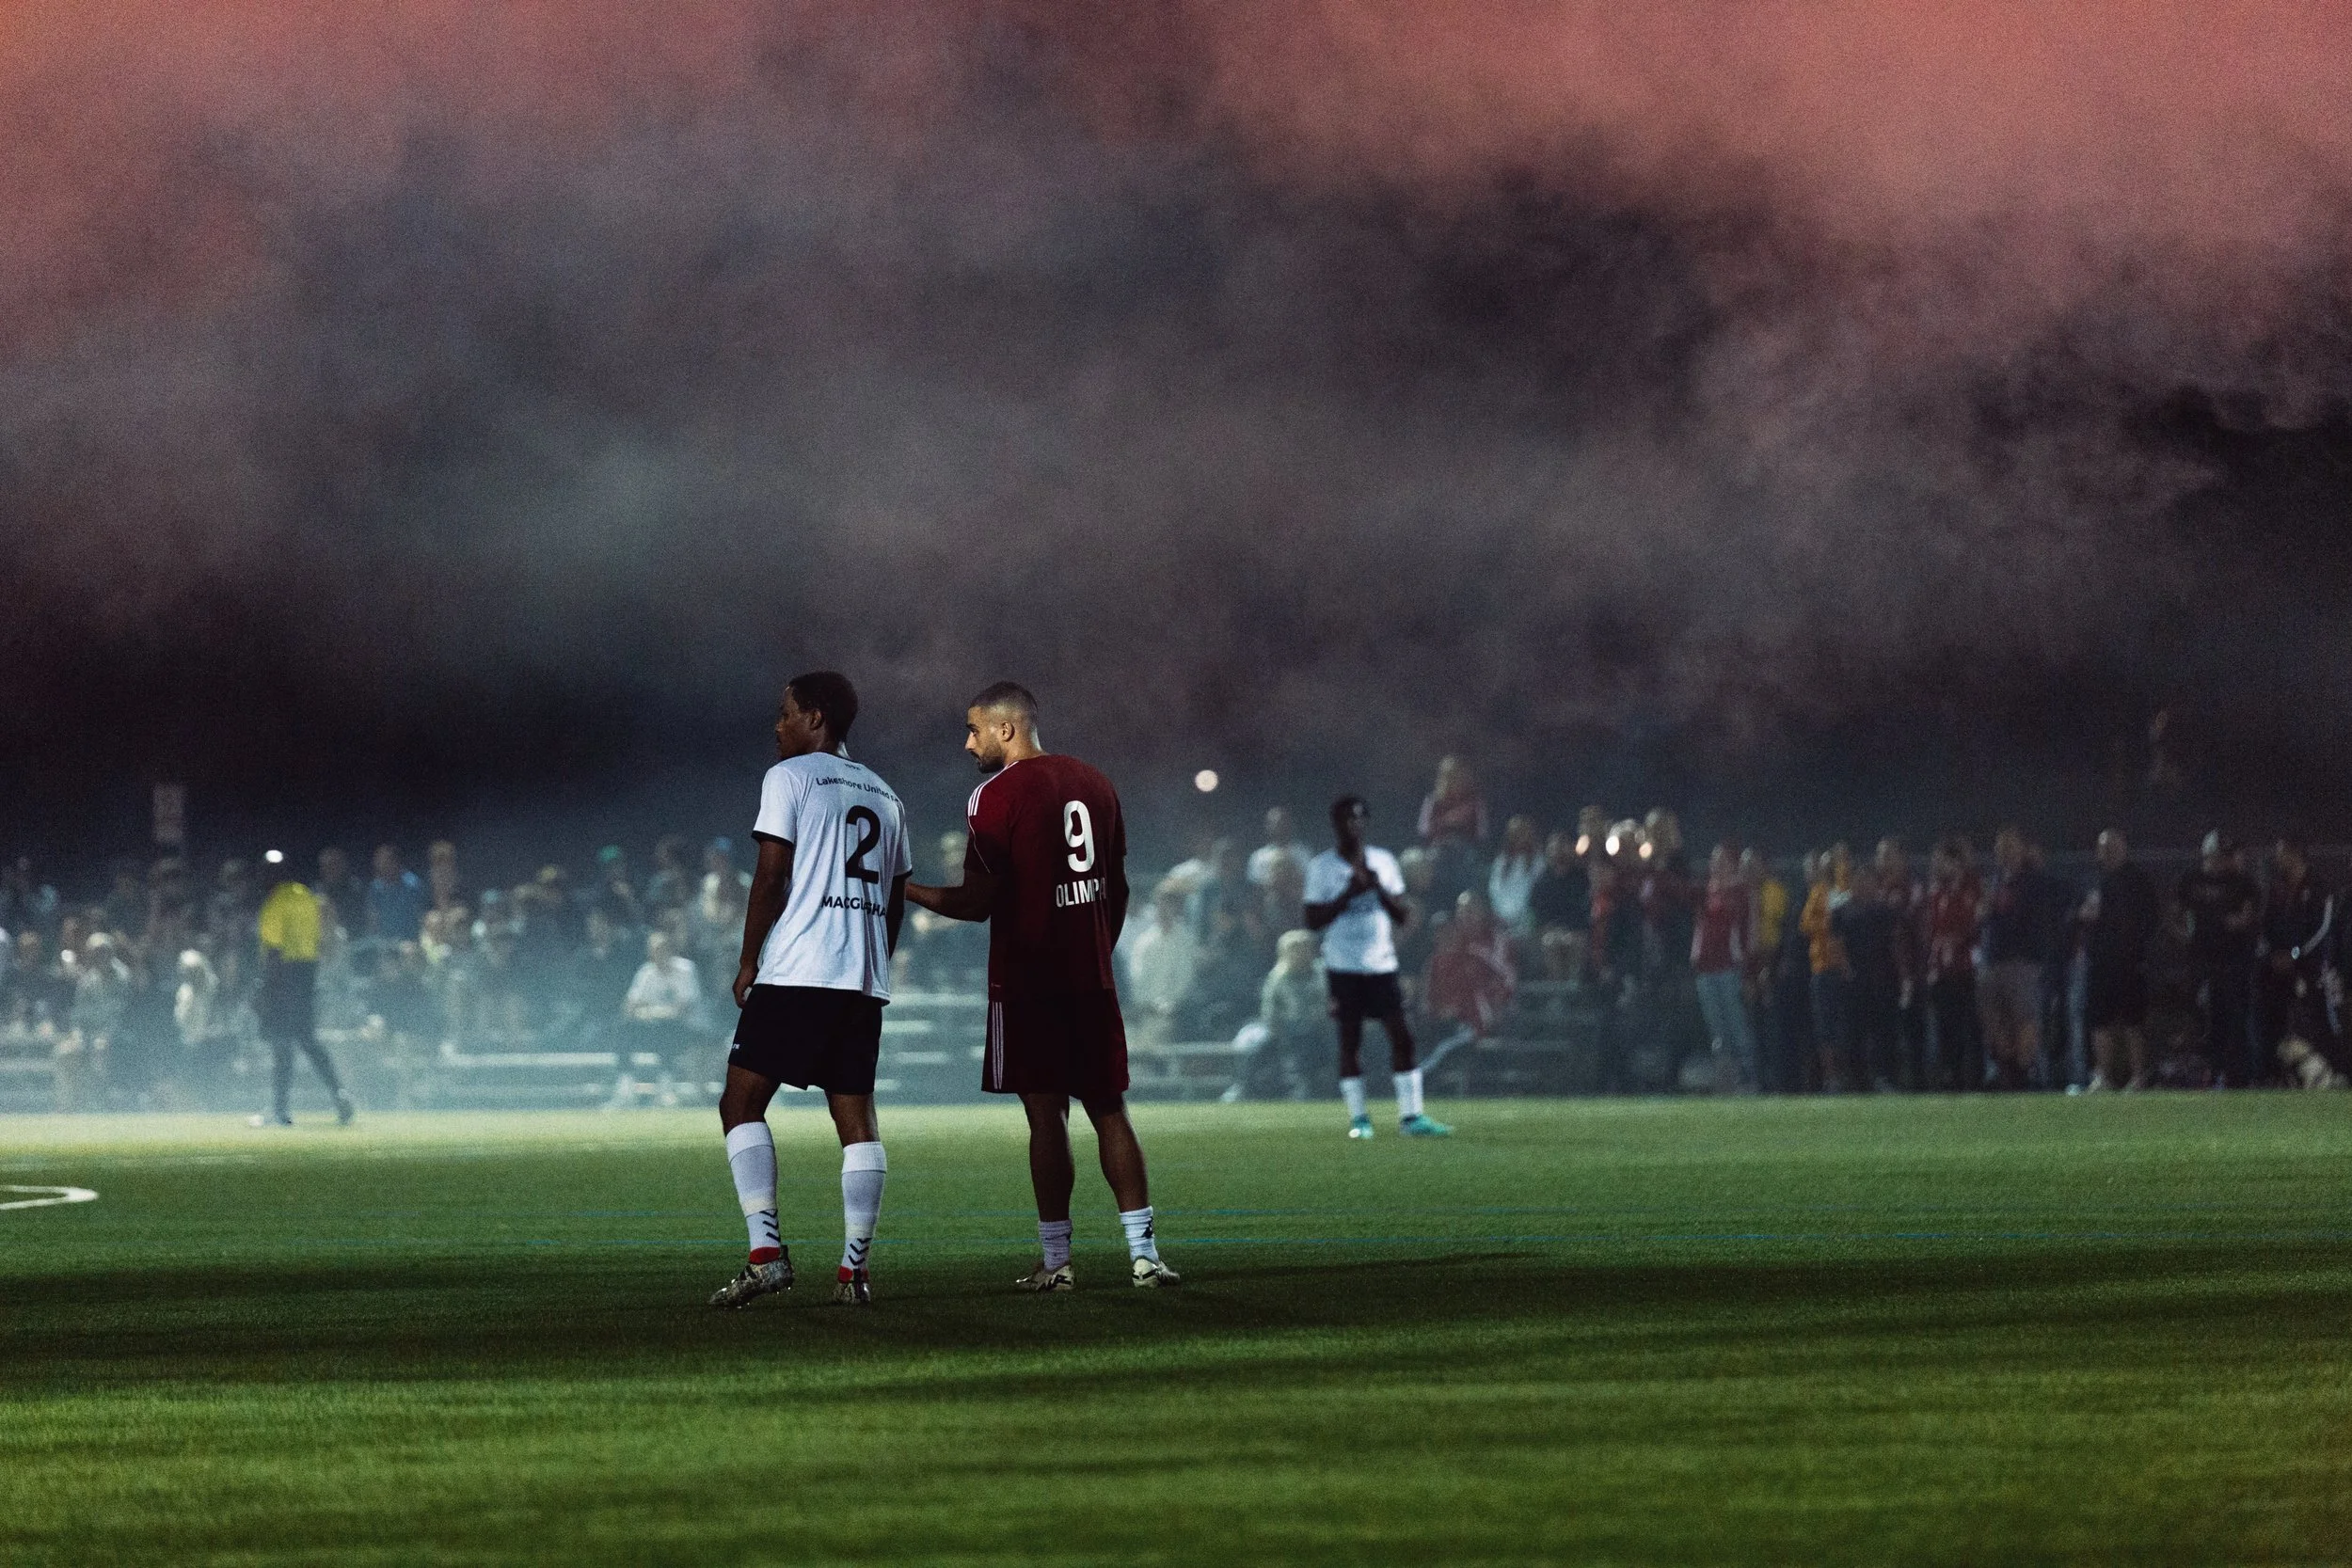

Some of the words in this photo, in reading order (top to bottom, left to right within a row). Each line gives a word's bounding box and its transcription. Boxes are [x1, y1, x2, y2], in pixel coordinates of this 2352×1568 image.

[816, 776, 862, 790] Lakeshore
[864, 784, 889, 800] United
[845, 804, 881, 885] 2
[1063, 800, 1095, 873] 9
